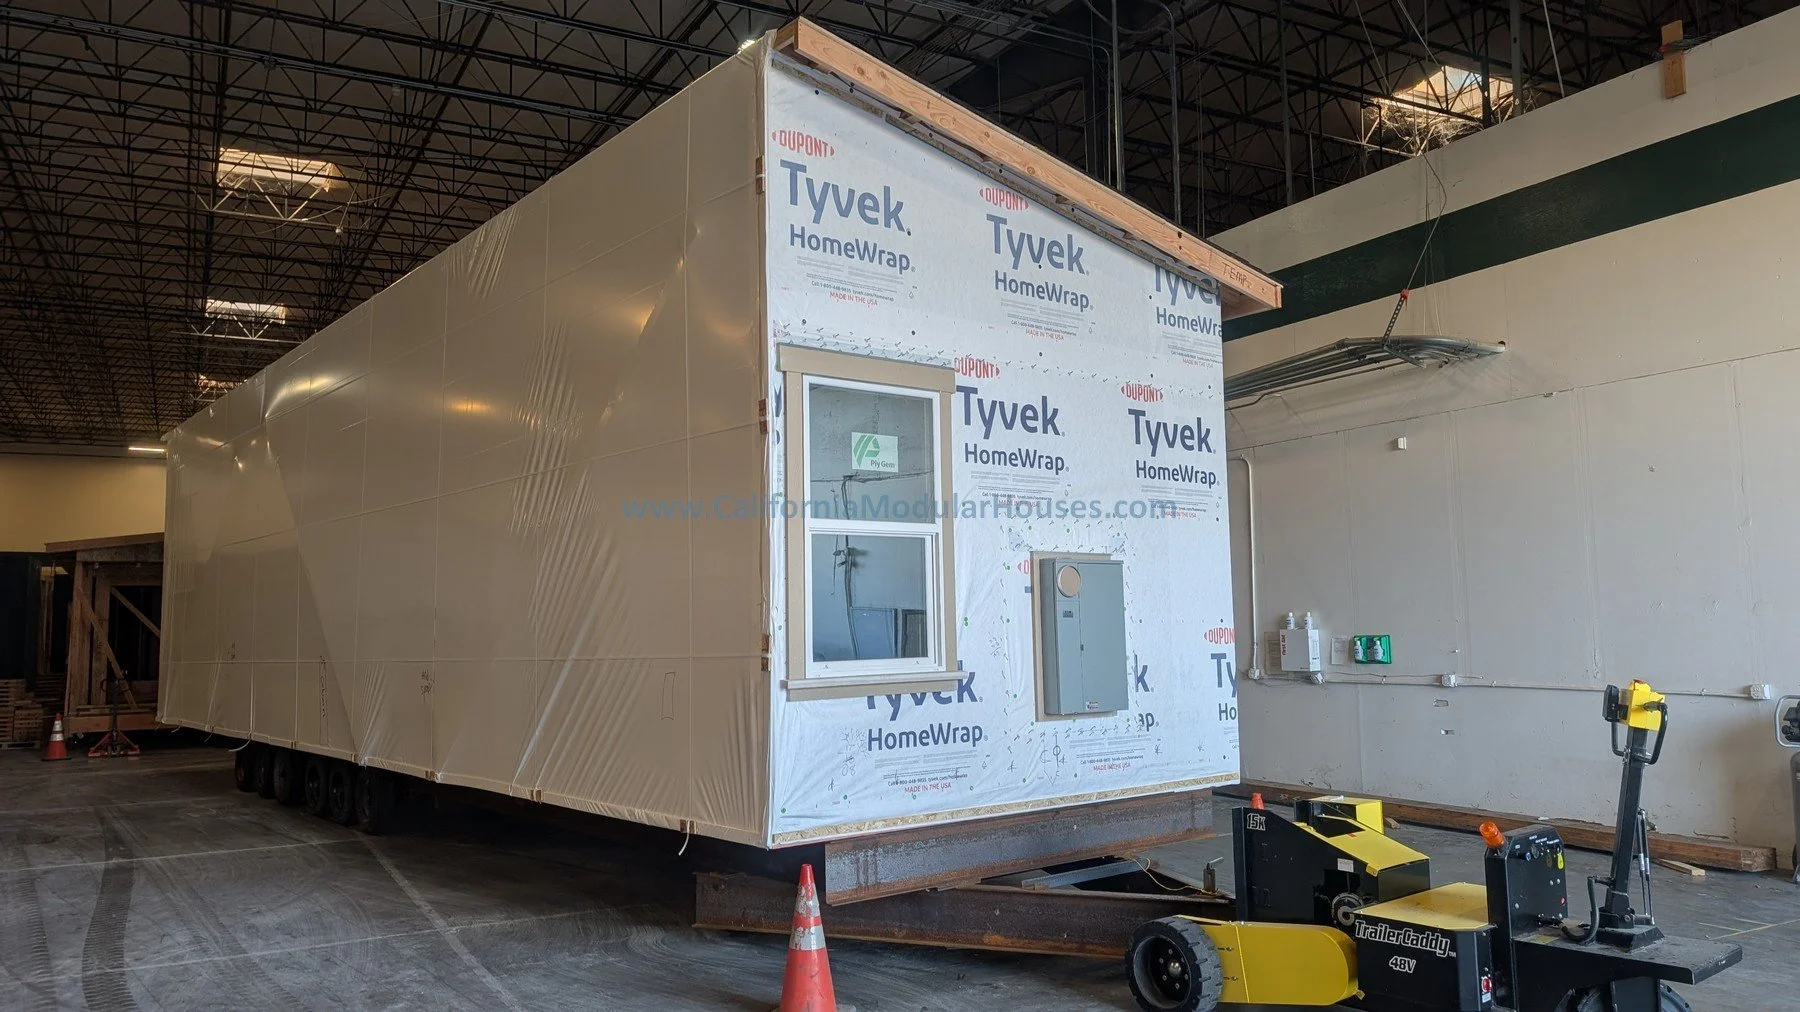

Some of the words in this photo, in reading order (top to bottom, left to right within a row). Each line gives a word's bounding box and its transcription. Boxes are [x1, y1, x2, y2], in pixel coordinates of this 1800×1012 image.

[779, 130, 828, 158] DUPONT
[779, 158, 906, 232] Tyvek
[985, 187, 1024, 211] DUPONT
[789, 223, 910, 275] HomeWrap
[986, 213, 1086, 275] Tyvek
[829, 291, 846, 301] MADE
[854, 295, 866, 304] THE
[866, 298, 878, 306] USA
[994, 269, 1090, 313] HomeWrap
[1054, 333, 1065, 341] USA
[1125, 383, 1159, 403] DUPONT
[955, 384, 1061, 440] Tyvek
[1127, 408, 1212, 457] Tyvek
[870, 459, 880, 470] Ply
[881, 460, 895, 469] Gem
[964, 442, 1065, 476] HomeWrap
[1135, 459, 1217, 490] HomeWrap
[867, 722, 983, 752] HomeWrap
[904, 785, 921, 794] MADE
[1246, 812, 1266, 831] 15K
[1355, 919, 1451, 958] TrailerCaddy
[1389, 956, 1416, 974] 48V
